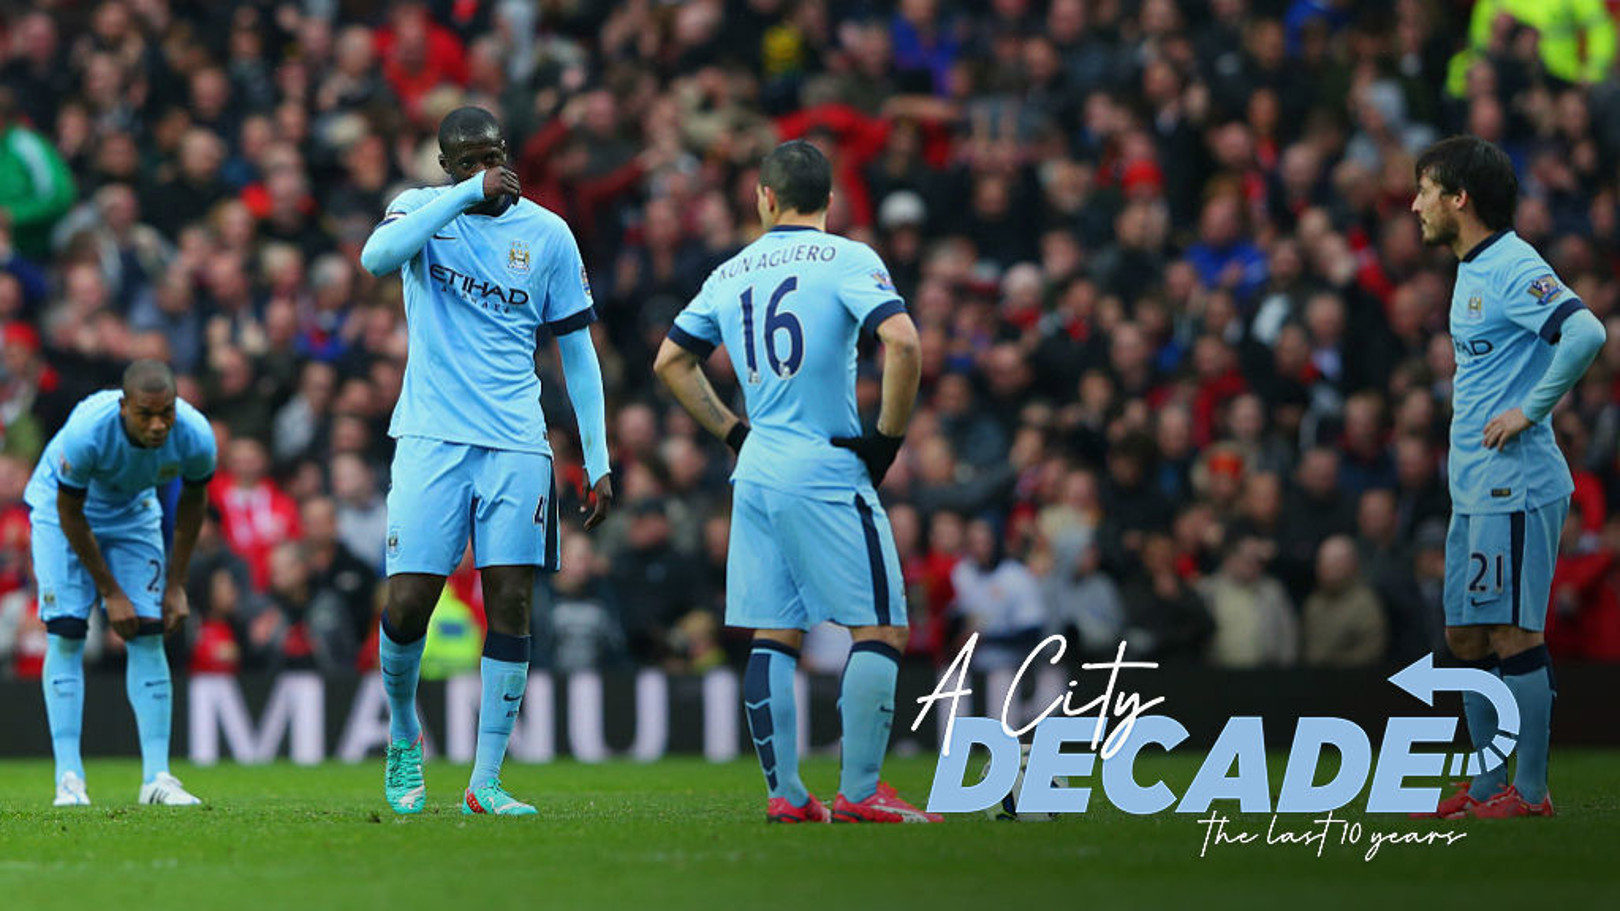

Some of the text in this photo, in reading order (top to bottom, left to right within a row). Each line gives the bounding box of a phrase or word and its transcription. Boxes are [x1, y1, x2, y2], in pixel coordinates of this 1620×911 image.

[430, 262, 529, 305] ETIHAD
[718, 244, 837, 281] KUN AGUERO
[739, 275, 804, 385] 16
[1468, 551, 1504, 594] 21
